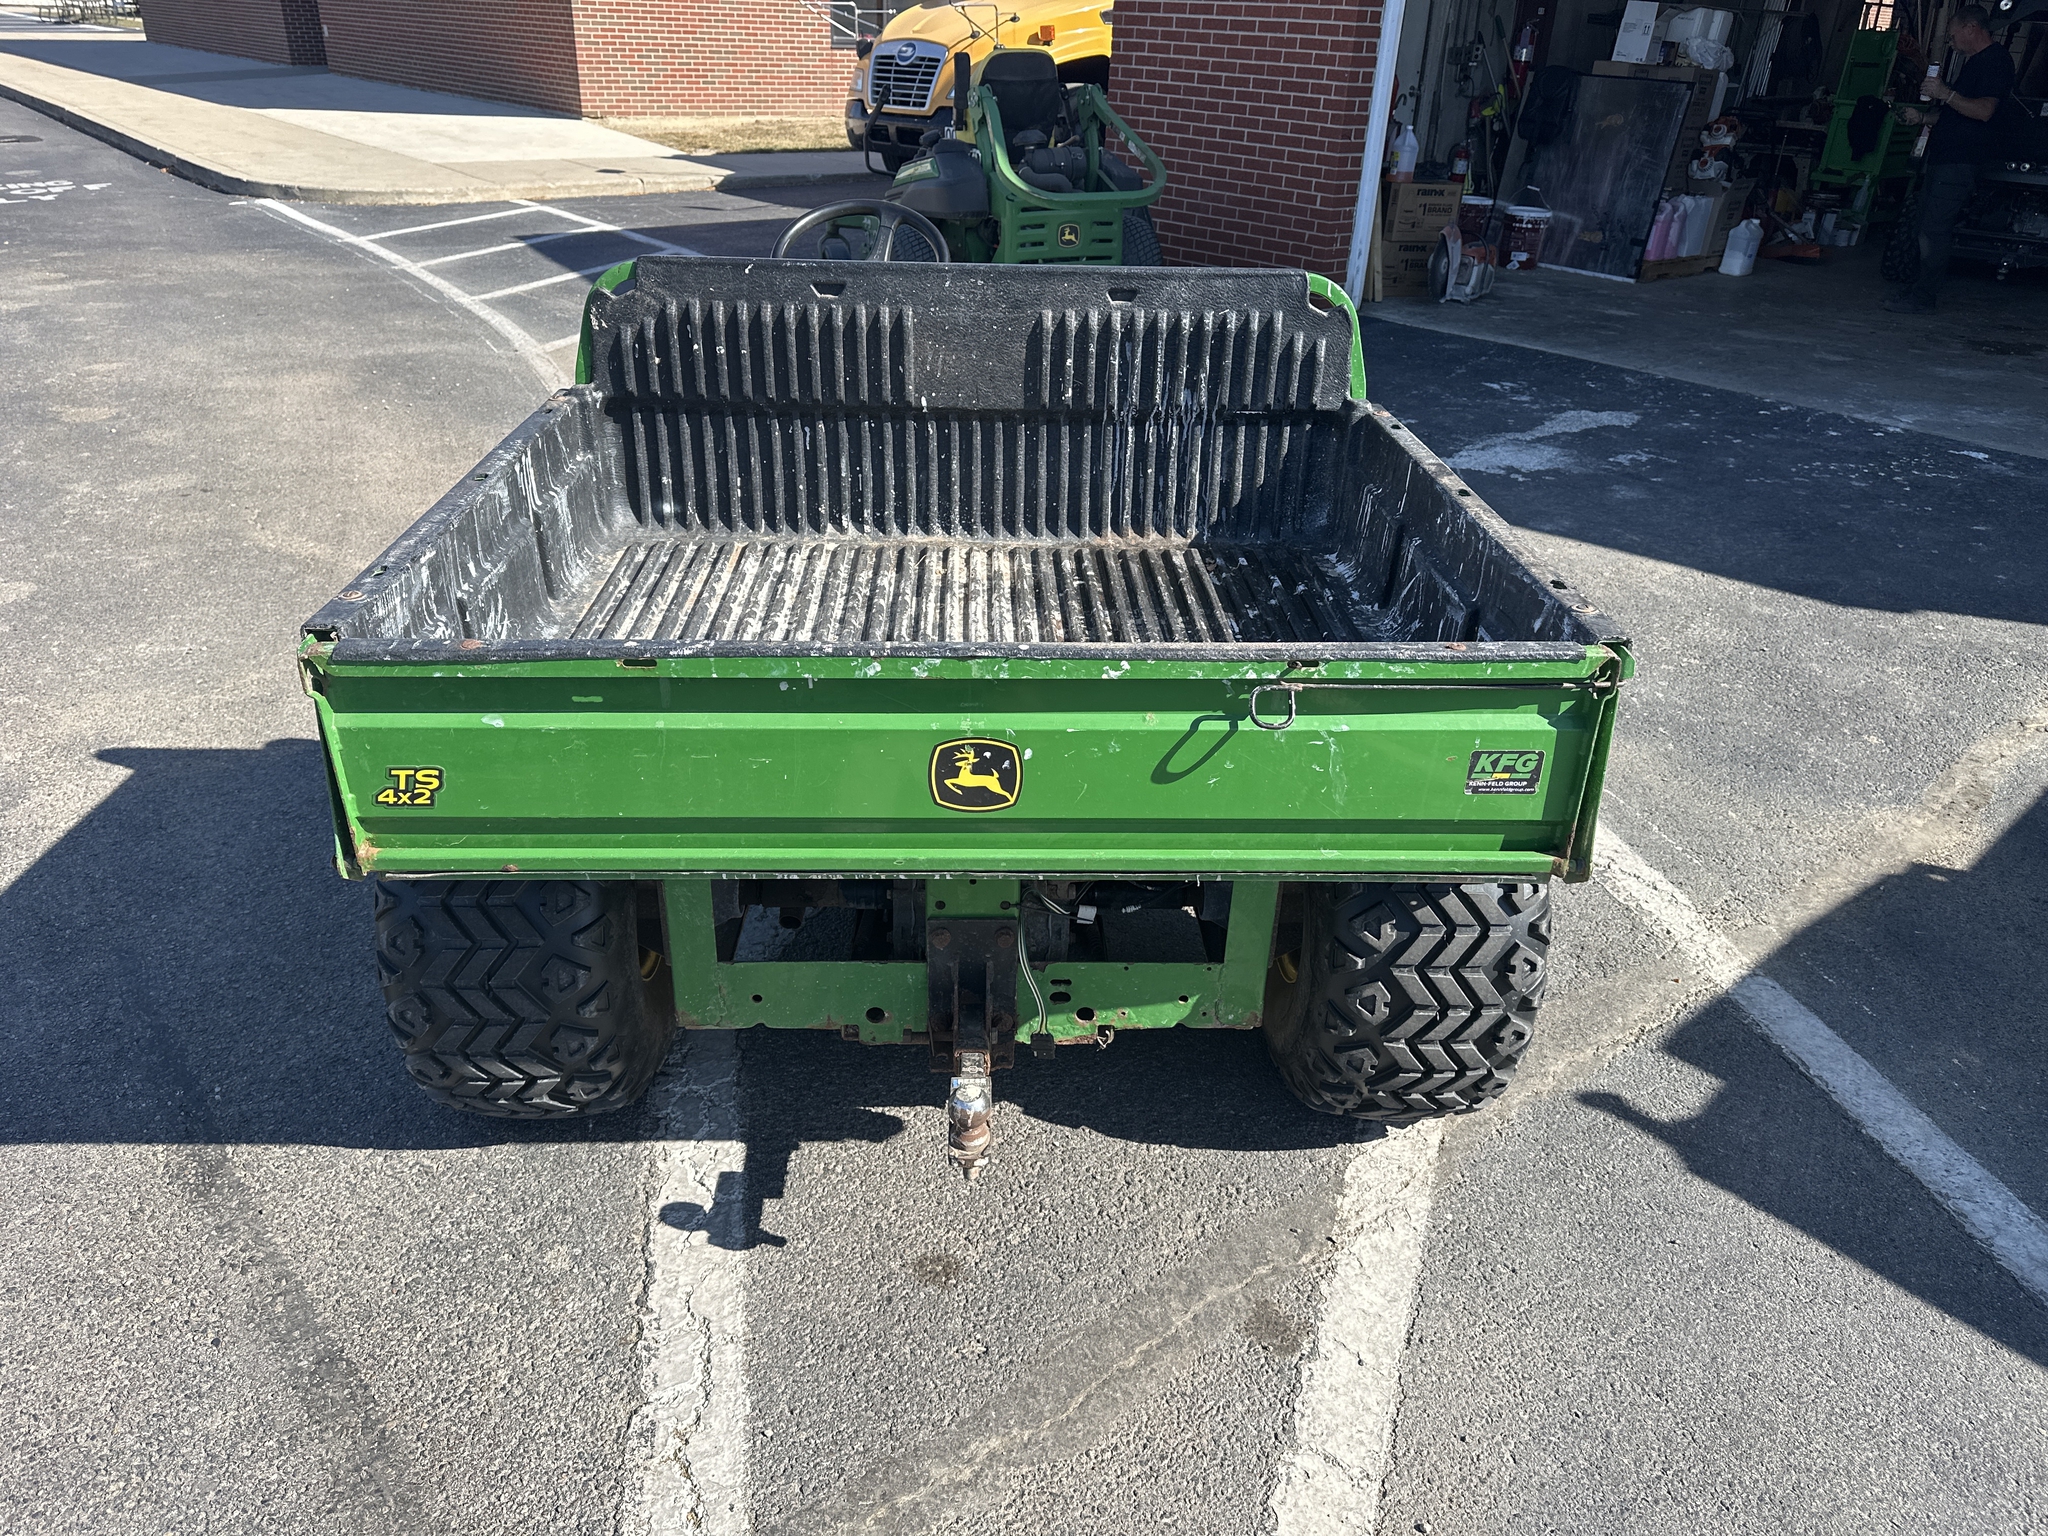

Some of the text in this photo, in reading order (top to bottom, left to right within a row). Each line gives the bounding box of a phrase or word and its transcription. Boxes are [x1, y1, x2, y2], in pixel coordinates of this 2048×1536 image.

[1474, 753, 1539, 773] KFG
[390, 769, 440, 790] TS
[377, 788, 431, 805] 4x2
